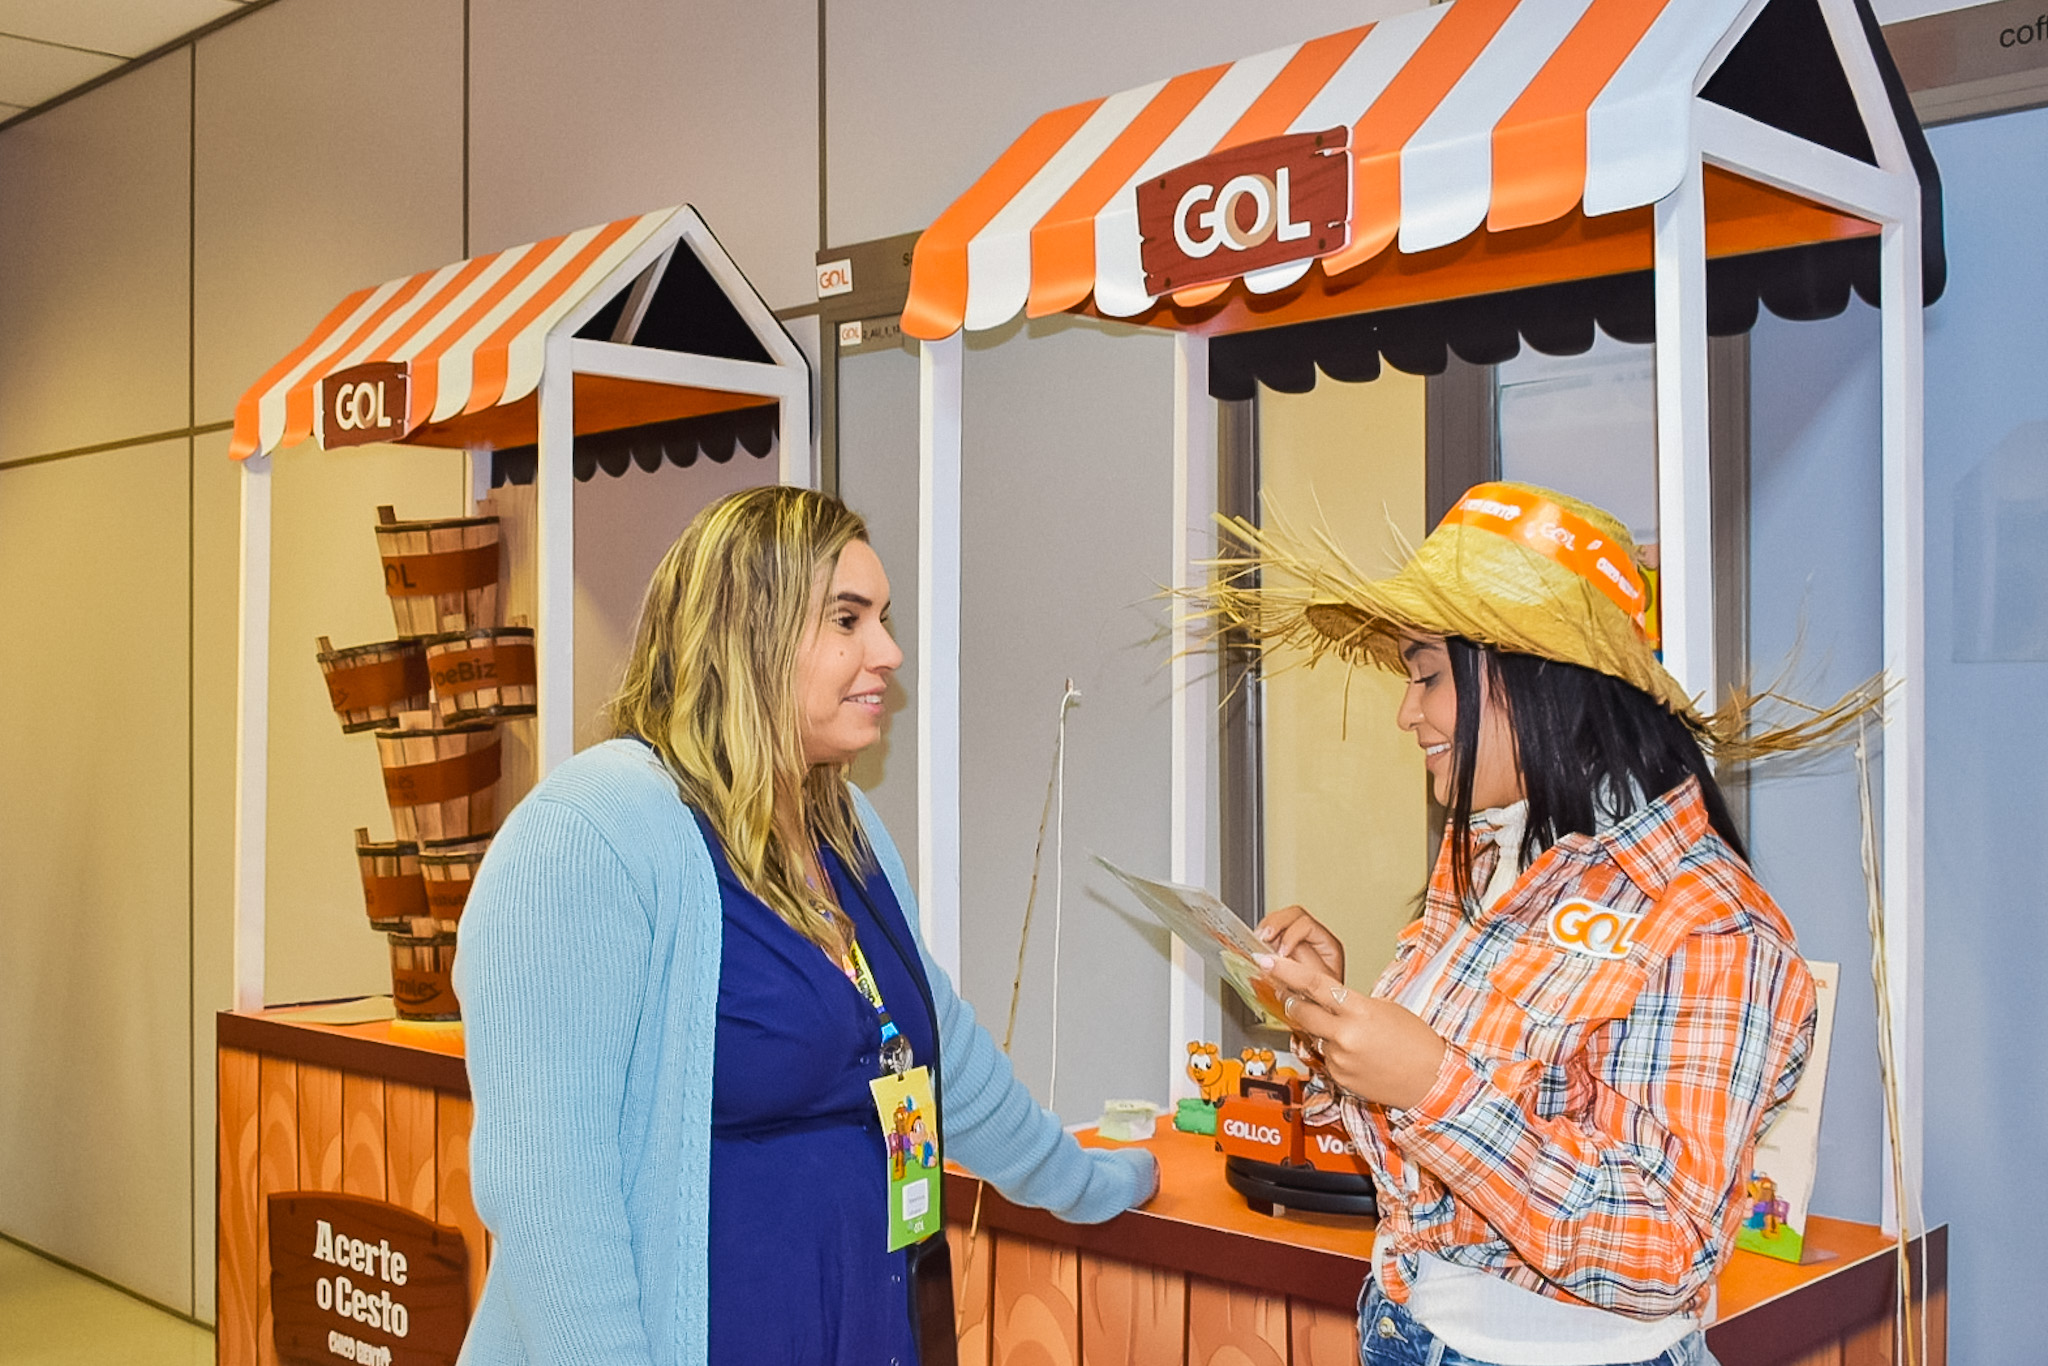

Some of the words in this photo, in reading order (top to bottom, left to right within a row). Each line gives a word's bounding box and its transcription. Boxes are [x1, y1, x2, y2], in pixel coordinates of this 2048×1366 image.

[2000, 14, 2048, 48] cof
[1173, 166, 1311, 258] GOL
[819, 268, 849, 289] GOL
[335, 381, 392, 430] GOL
[1541, 522, 1575, 551] GOL
[384, 564, 416, 589] OL
[436, 657, 498, 687] oeBiz
[1554, 903, 1636, 953] GOL
[1223, 1119, 1282, 1145] GOLLOG
[313, 1219, 408, 1286] Acerte
[316, 1277, 332, 1311] o
[335, 1276, 409, 1338] Cesto
